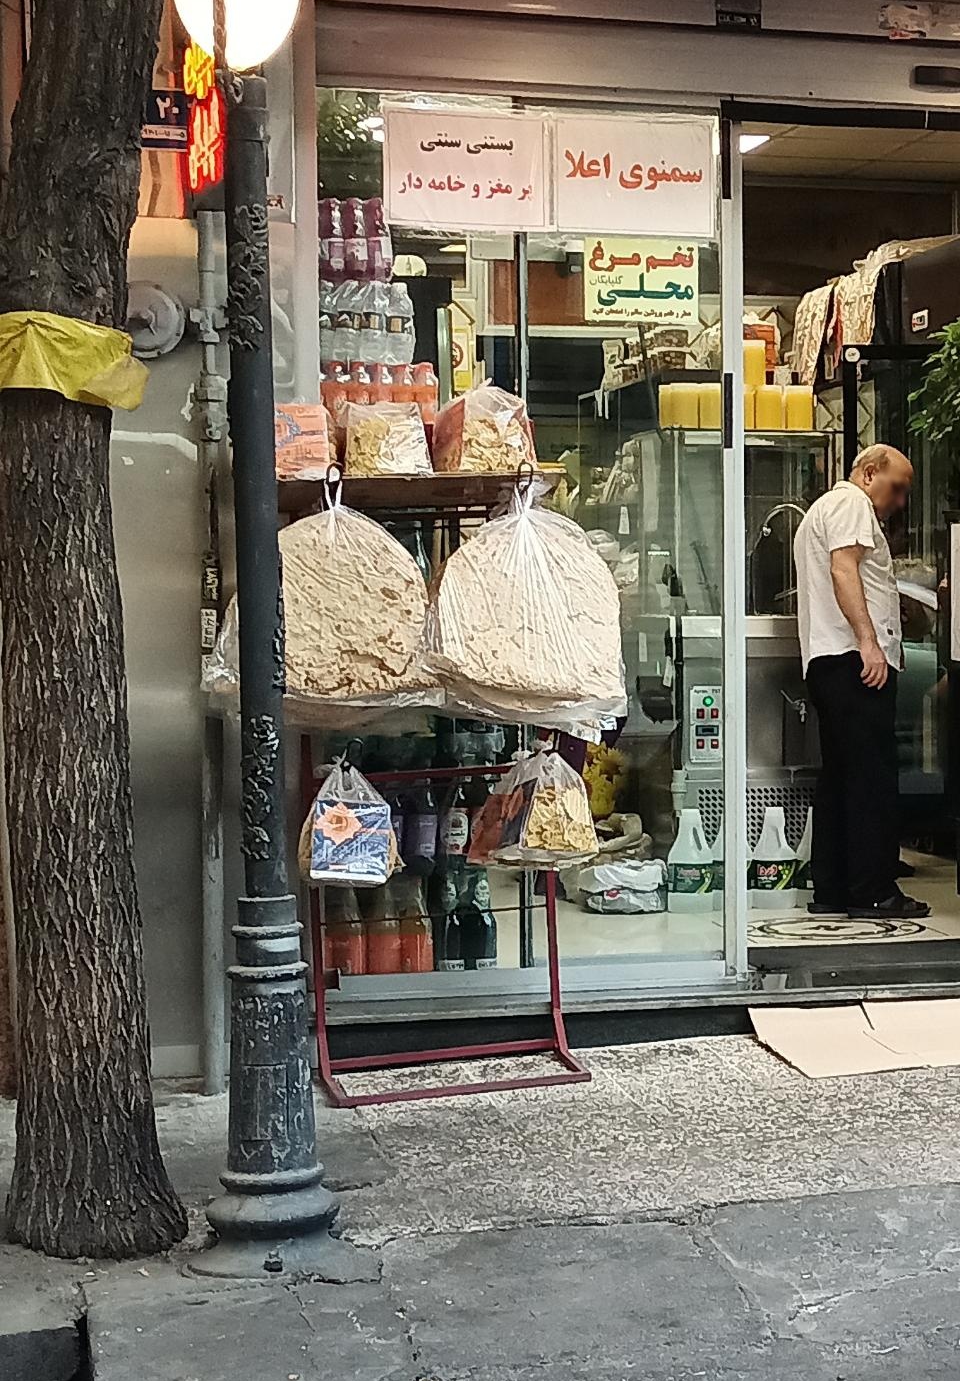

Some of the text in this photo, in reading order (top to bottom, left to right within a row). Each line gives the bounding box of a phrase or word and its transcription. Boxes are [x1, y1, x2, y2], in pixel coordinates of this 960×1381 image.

[420, 132, 514, 156] بستنی سنتی
[565, 149, 703, 190] سمنوی اعلا
[398, 172, 423, 193] دار
[427, 175, 466, 192] خامه
[471, 183, 481, 198] و
[485, 178, 513, 199] مغز
[588, 240, 695, 274] تخم مرغ
[597, 272, 695, 306] محلی
